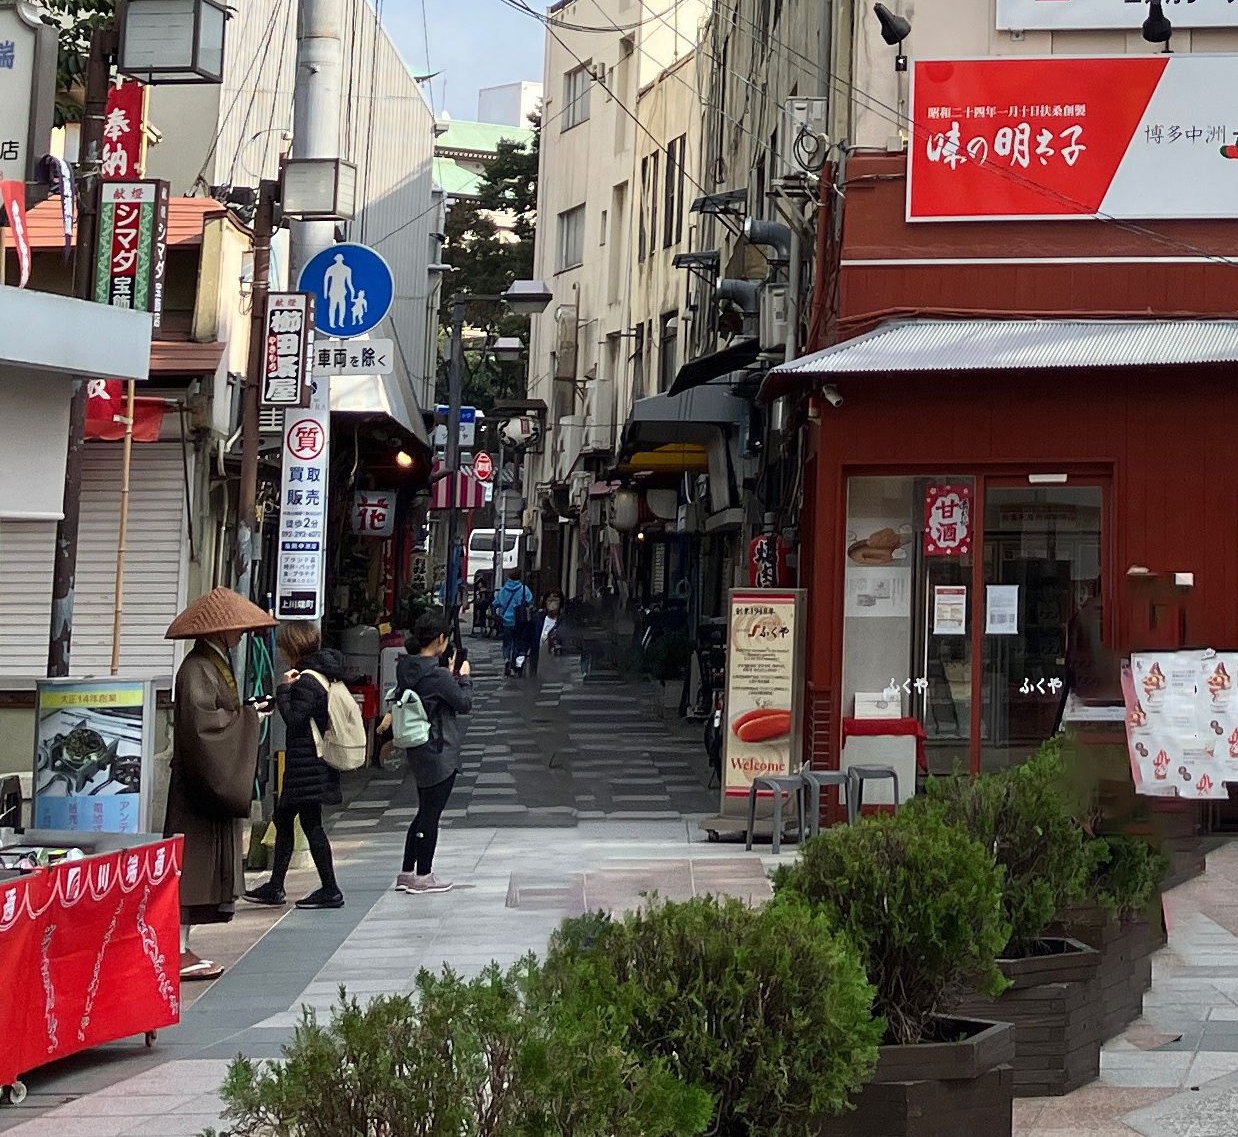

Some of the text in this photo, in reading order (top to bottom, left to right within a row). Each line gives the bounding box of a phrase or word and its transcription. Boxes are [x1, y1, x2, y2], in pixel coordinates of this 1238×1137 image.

[102, 107, 131, 177] 奉納
[1144, 125, 1226, 144] 博多中洲
[313, 347, 387, 369] 車両を除く
[295, 426, 320, 453] 質
[289, 466, 321, 483] 買取
[287, 489, 321, 506] 販売
[935, 498, 959, 543] 甘酒
[1019, 677, 1064, 695] ふくや
[730, 757, 787, 773] Welcome
